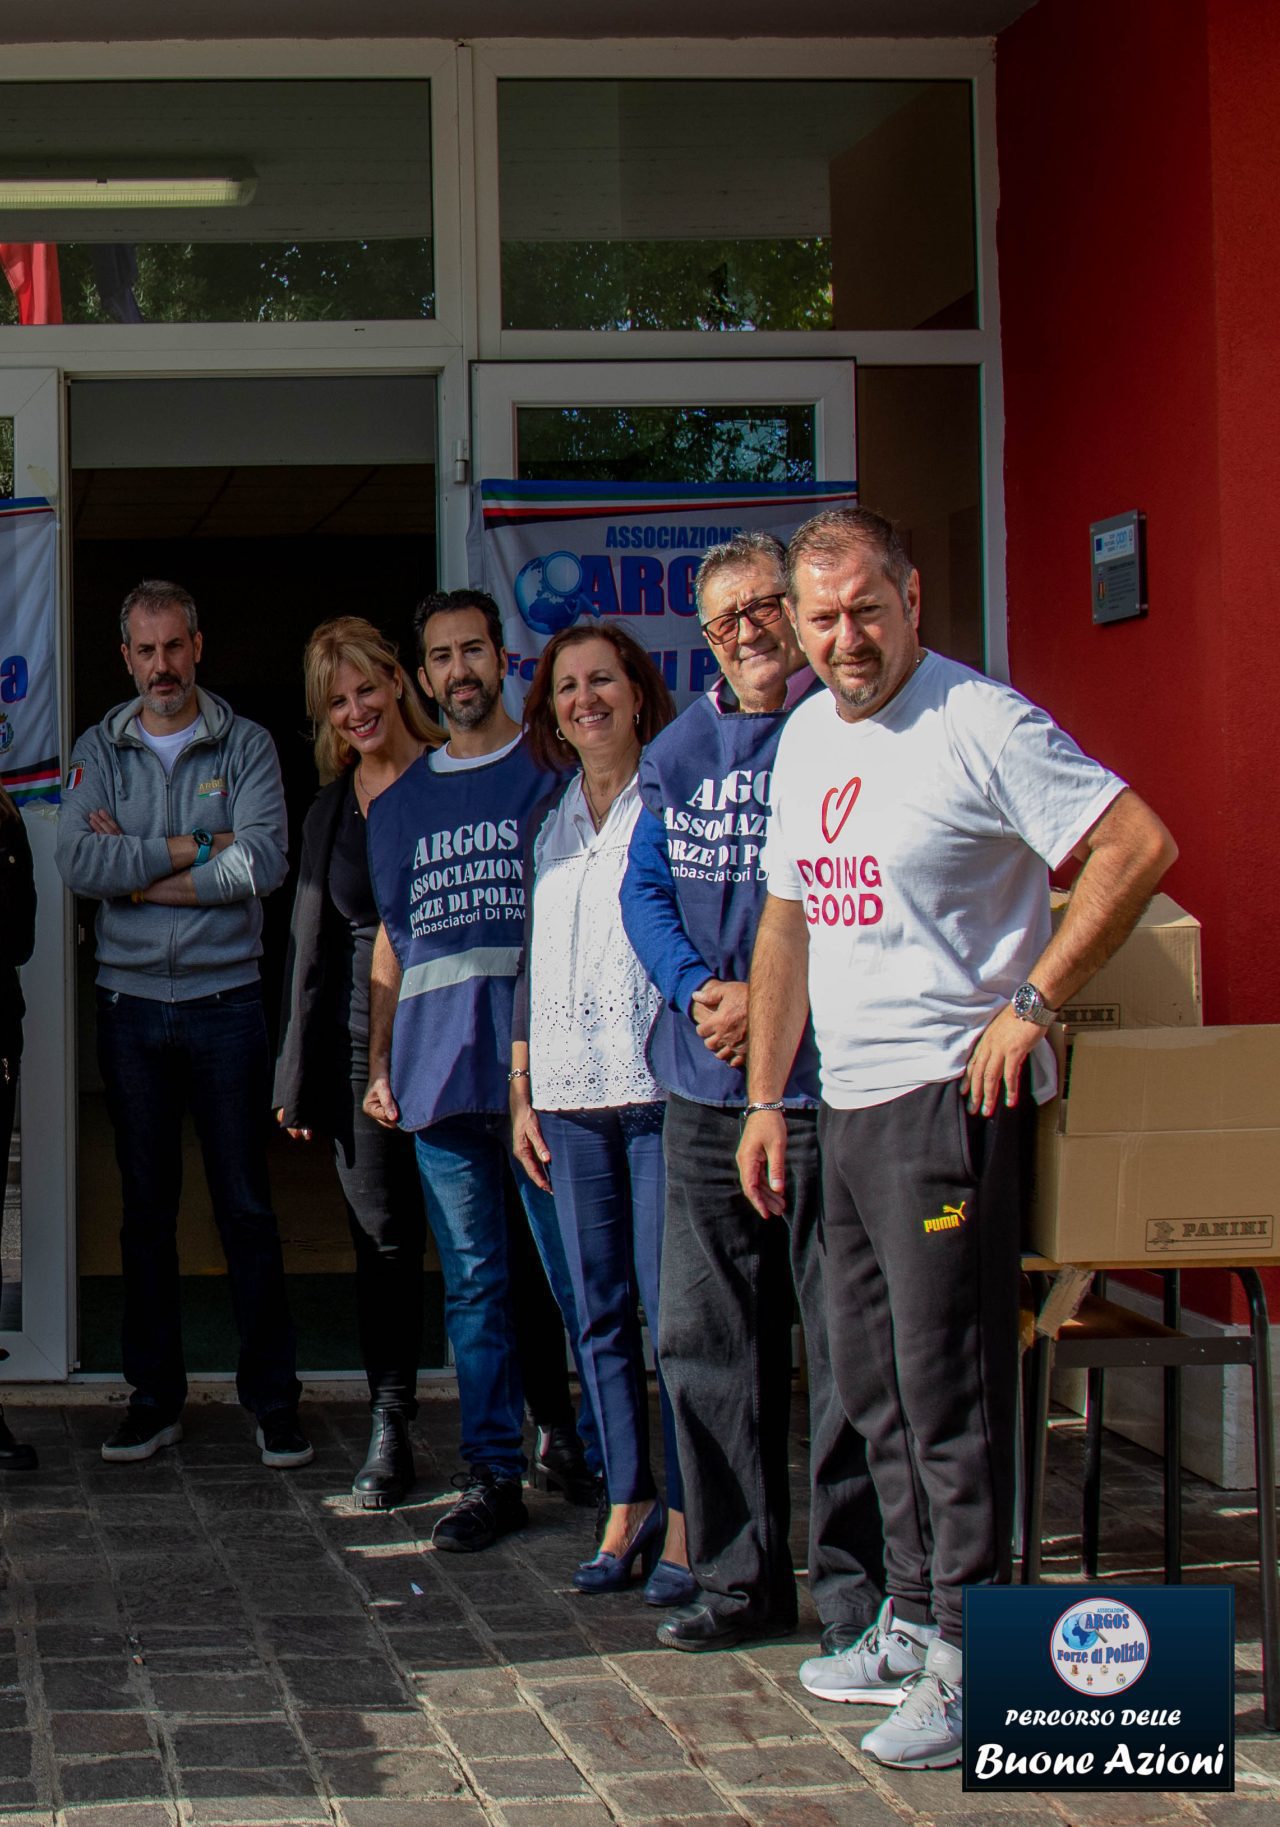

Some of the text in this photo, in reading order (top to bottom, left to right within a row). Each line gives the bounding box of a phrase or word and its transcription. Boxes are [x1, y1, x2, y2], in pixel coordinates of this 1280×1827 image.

[606, 525, 742, 549] ASSOCIAZION
[581, 554, 704, 617] ARG
[686, 770, 773, 811] AGO
[664, 807, 767, 842] ASSOIAZ
[413, 819, 519, 870] ARGOS
[667, 839, 716, 867] RZE
[409, 858, 524, 904] ASSOCIAZION
[671, 863, 768, 883] mbasciatori D
[797, 855, 882, 888] DOING
[447, 891, 469, 913] DI
[485, 907, 500, 920] Di
[805, 893, 884, 927] GOOD
[1056, 1008, 1114, 1022] NINI
[923, 1214, 960, 1233] PUMA
[1182, 1220, 1268, 1237] PANINI
